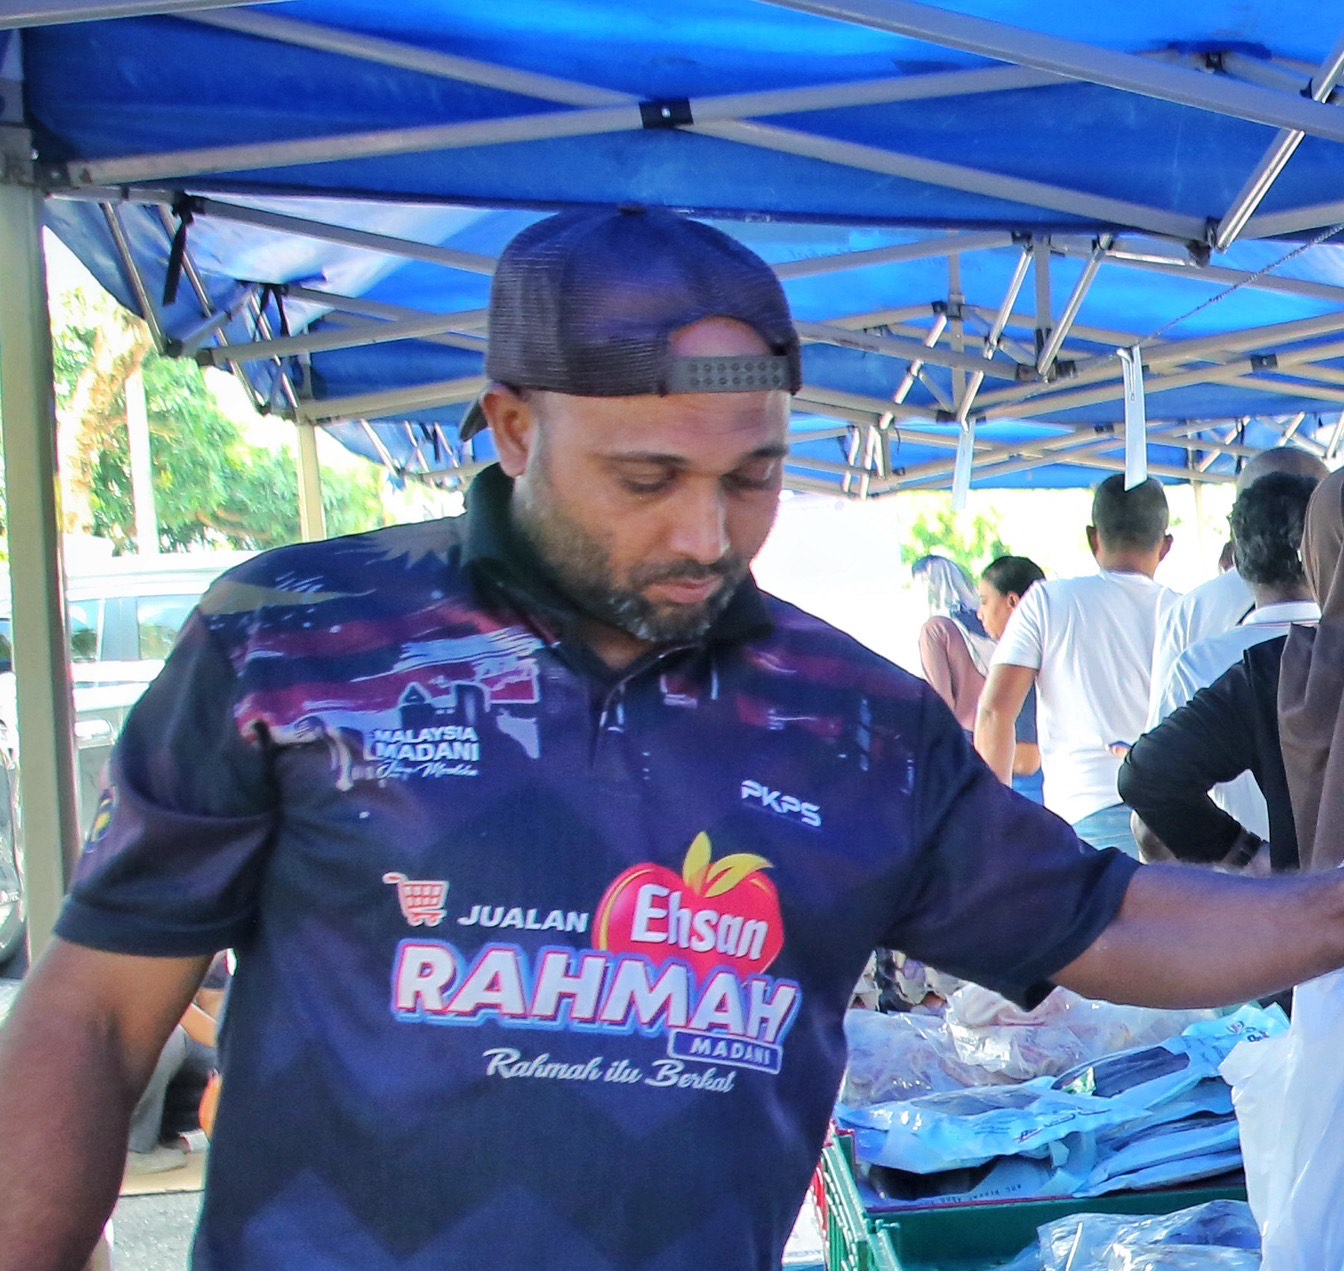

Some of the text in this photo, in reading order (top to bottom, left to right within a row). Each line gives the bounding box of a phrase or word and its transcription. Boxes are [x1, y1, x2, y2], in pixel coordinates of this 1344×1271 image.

[373, 726, 478, 743] MALAYSIA
[374, 741, 480, 763] MADANI
[741, 780, 822, 827] PKPS
[457, 904, 590, 933] JUALAN
[630, 884, 770, 961] Ehsan
[394, 943, 799, 1045] RAHMAH
[482, 1047, 736, 1094] Rahmah itu Berkat
[689, 1037, 772, 1067] MADANI
